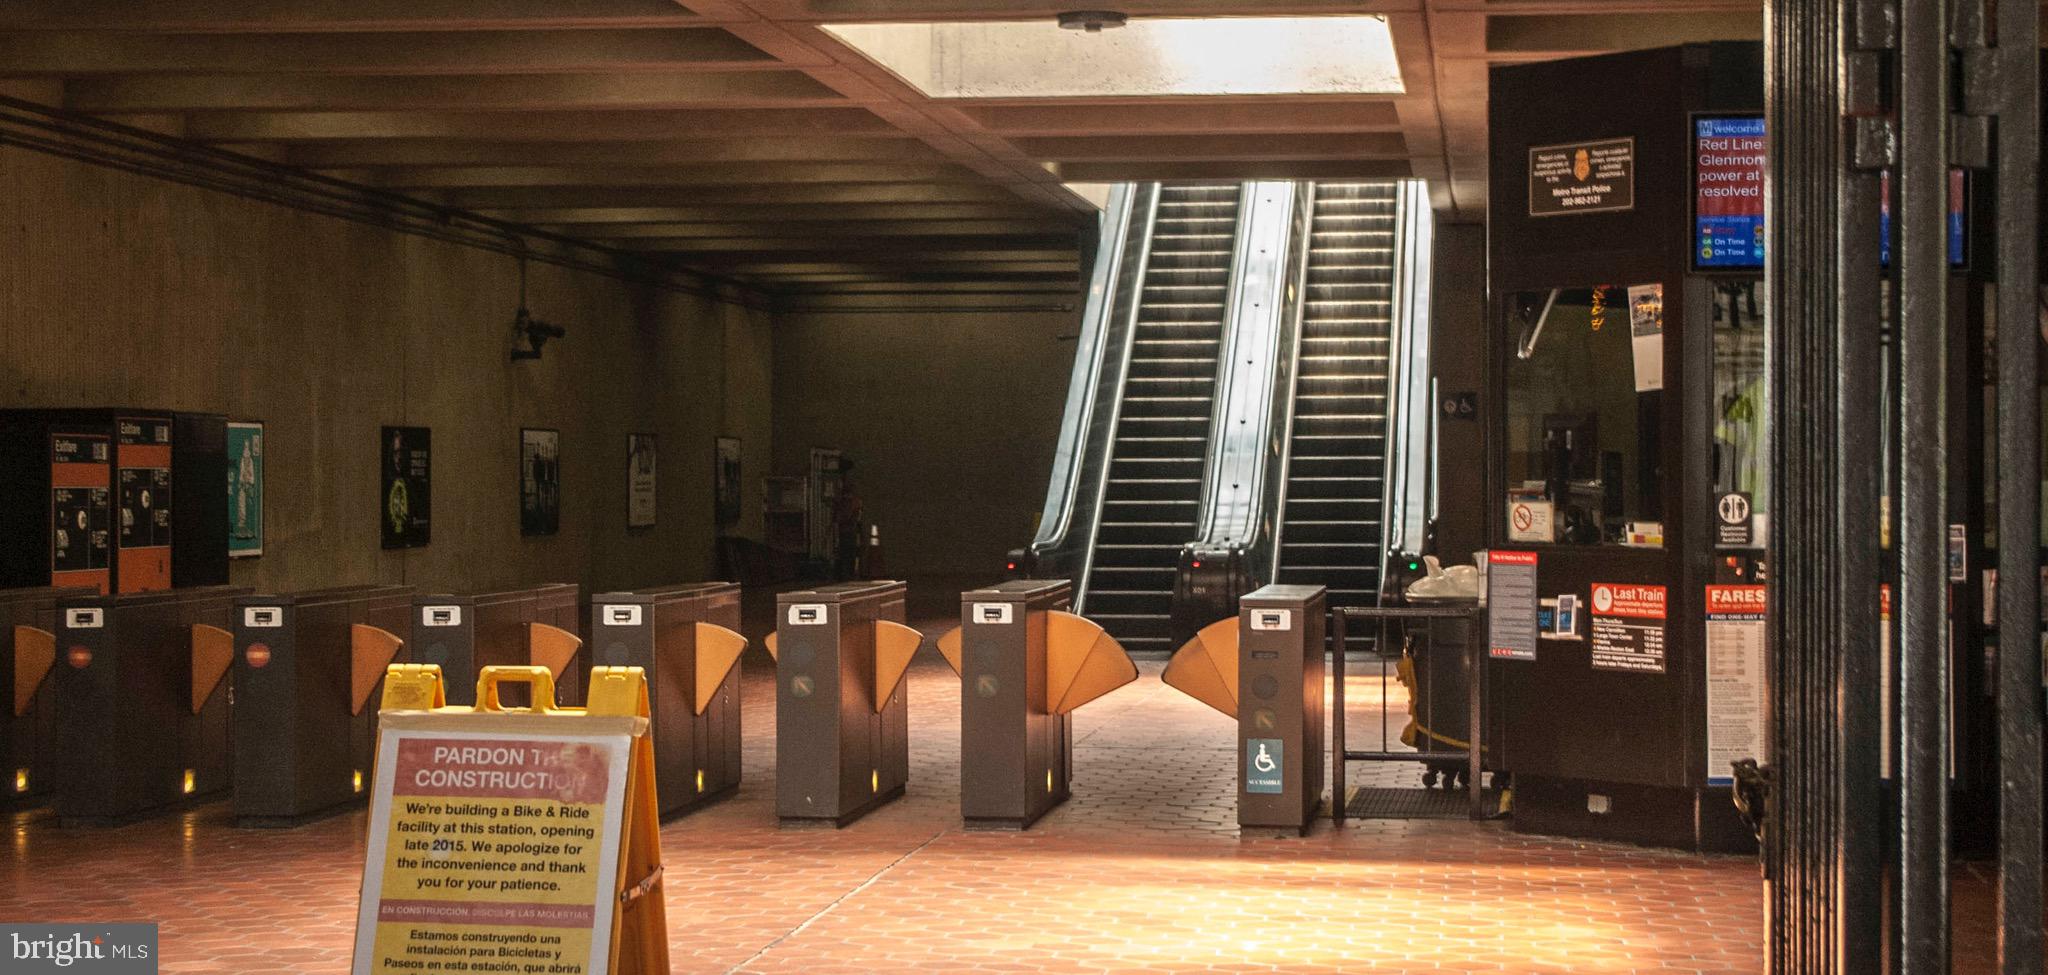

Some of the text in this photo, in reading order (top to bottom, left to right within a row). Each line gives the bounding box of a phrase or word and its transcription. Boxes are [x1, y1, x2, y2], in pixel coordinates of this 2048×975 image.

[1714, 125, 1760, 134] welcome
[1700, 139, 1728, 150] Red
[1700, 170, 1759, 183] power at
[1552, 185, 1611, 196] Metro Transit Police
[1700, 185, 1759, 197] resolved
[1714, 238, 1725, 246] On
[1714, 248, 1725, 256] On
[1727, 248, 1745, 256] Time
[1613, 587, 1663, 602] Last Train
[1711, 590, 1766, 603] FARES
[434, 746, 525, 765] PARDON
[406, 803, 589, 818] We're building a Bike & Ride
[397, 821, 594, 839] facility at this station, opening
[405, 840, 582, 856] late 2015. We apologize for
[397, 858, 586, 873] the inconvenience and thank
[417, 877, 560, 892] you for your patience.
[518, 909, 535, 917] LAS
[410, 930, 561, 944] Estamos construyendo una
[406, 944, 561, 960] instalación para Bicicletas y
[384, 957, 581, 974] Paseos en esta estación, que abrirá
